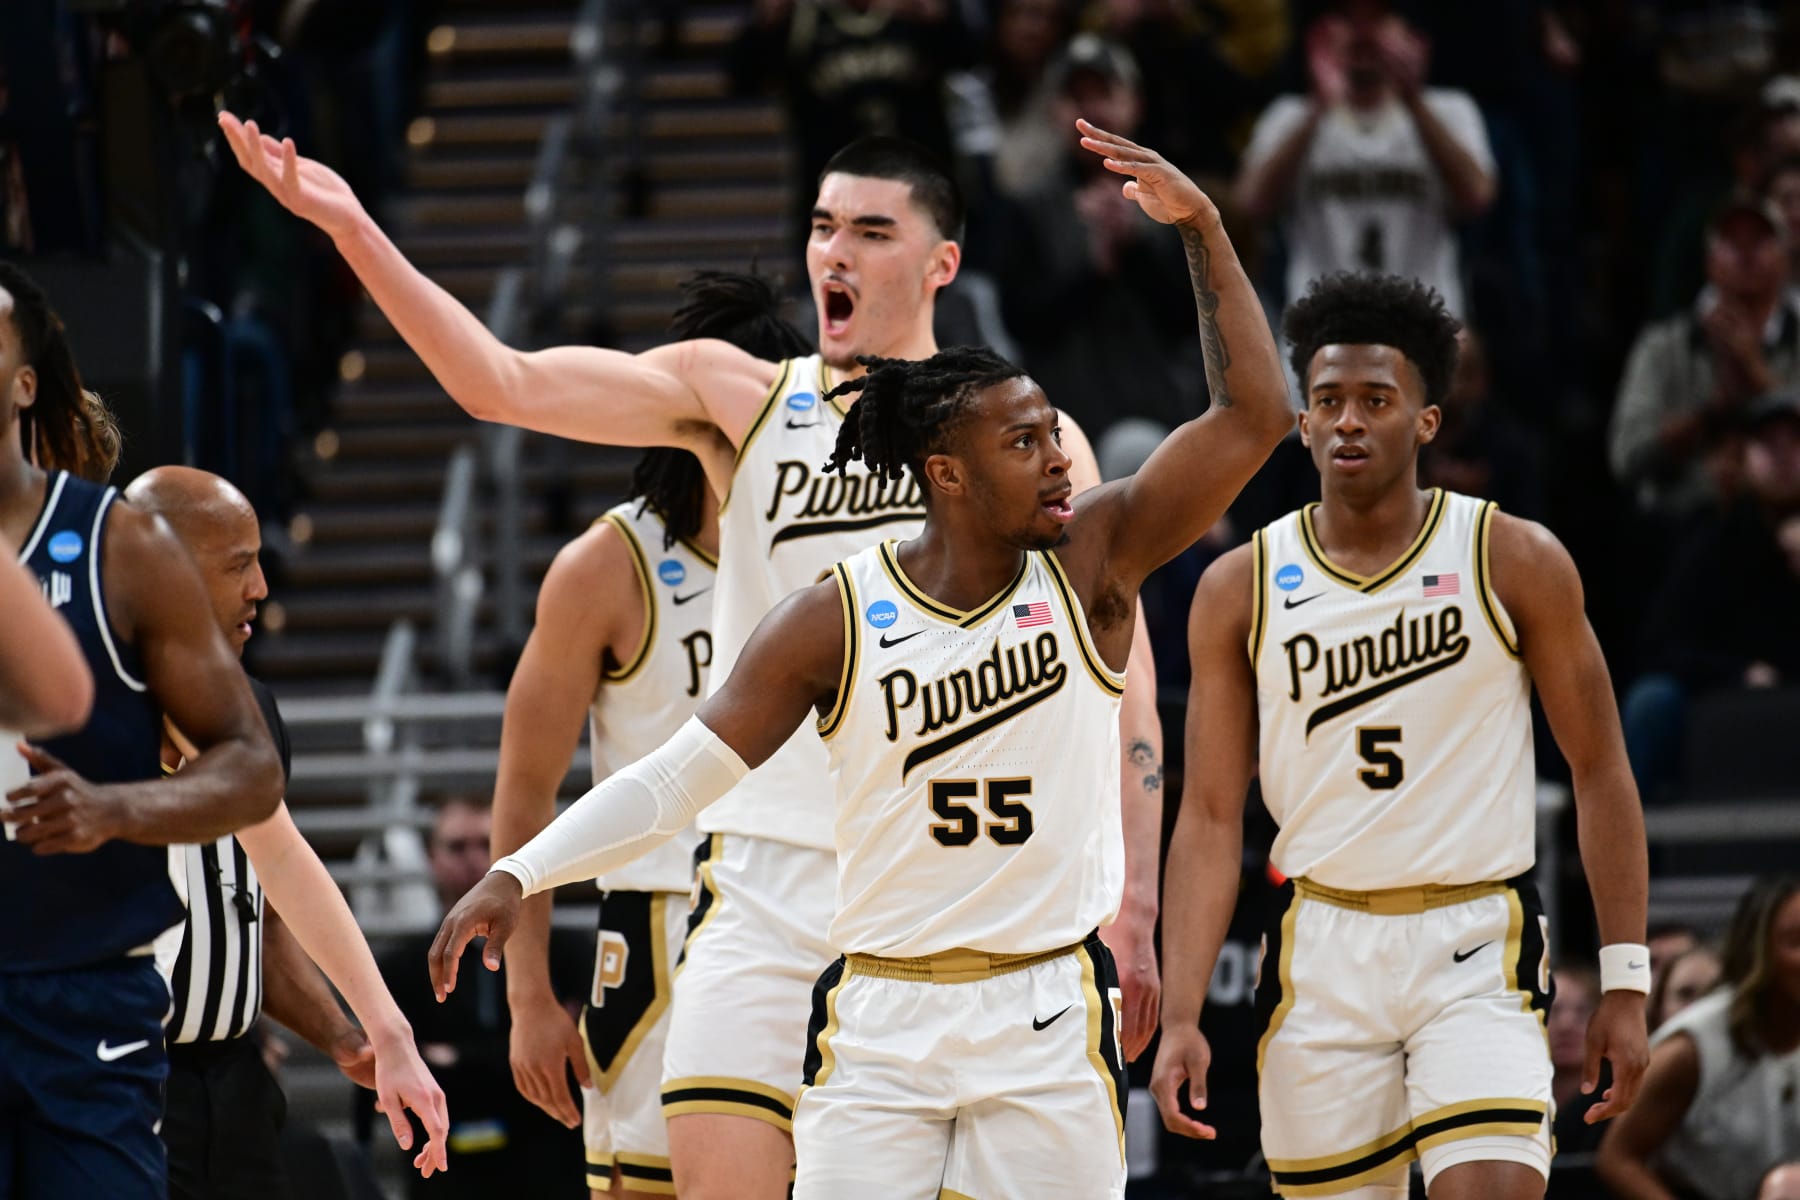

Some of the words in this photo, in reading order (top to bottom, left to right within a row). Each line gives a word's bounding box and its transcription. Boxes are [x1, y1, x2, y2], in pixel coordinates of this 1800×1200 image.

[766, 460, 927, 522] Purdu
[871, 611, 896, 622] NCAA
[877, 631, 1068, 744] Purdue
[1281, 605, 1470, 703] Purdue
[1356, 725, 1404, 790] 5
[928, 776, 1035, 847] 55
[591, 929, 630, 1008] P
